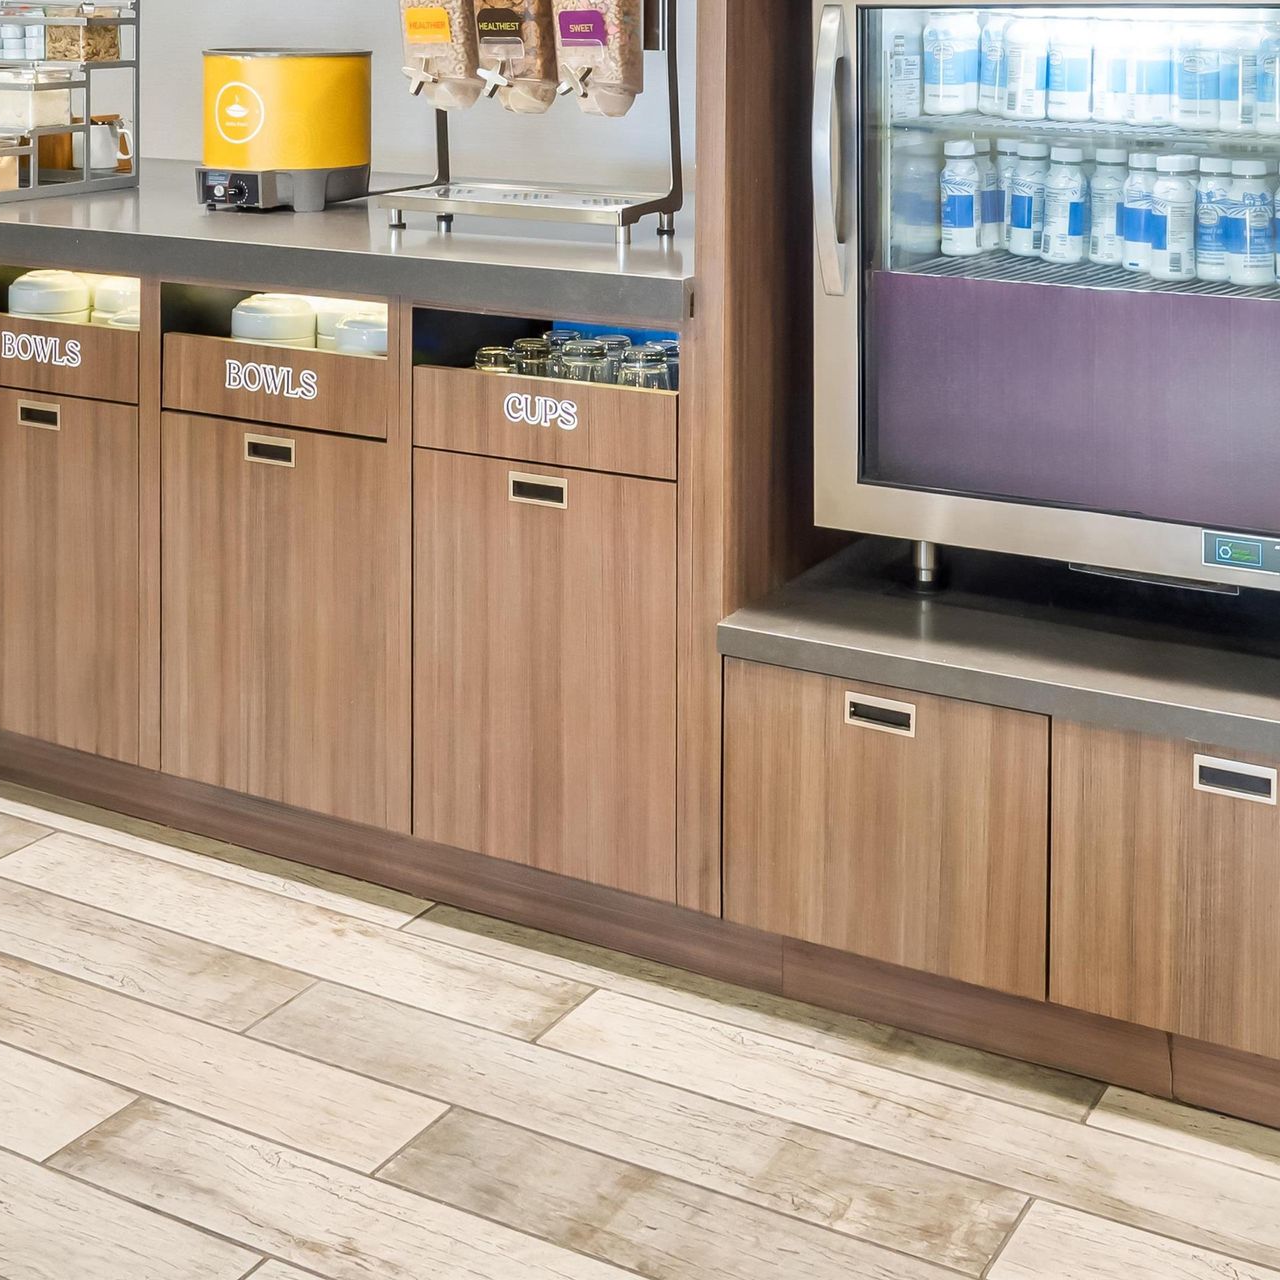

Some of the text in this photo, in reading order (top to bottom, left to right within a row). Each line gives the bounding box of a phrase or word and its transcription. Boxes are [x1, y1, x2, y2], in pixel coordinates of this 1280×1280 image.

[410, 21, 445, 29] HEALTHIER
[479, 22, 519, 31] HEALTHIEST
[569, 23, 593, 32] SWEET
[1, 331, 81, 367] BOWLS
[225, 359, 317, 400] BOWLS
[503, 392, 577, 430] CUPS
